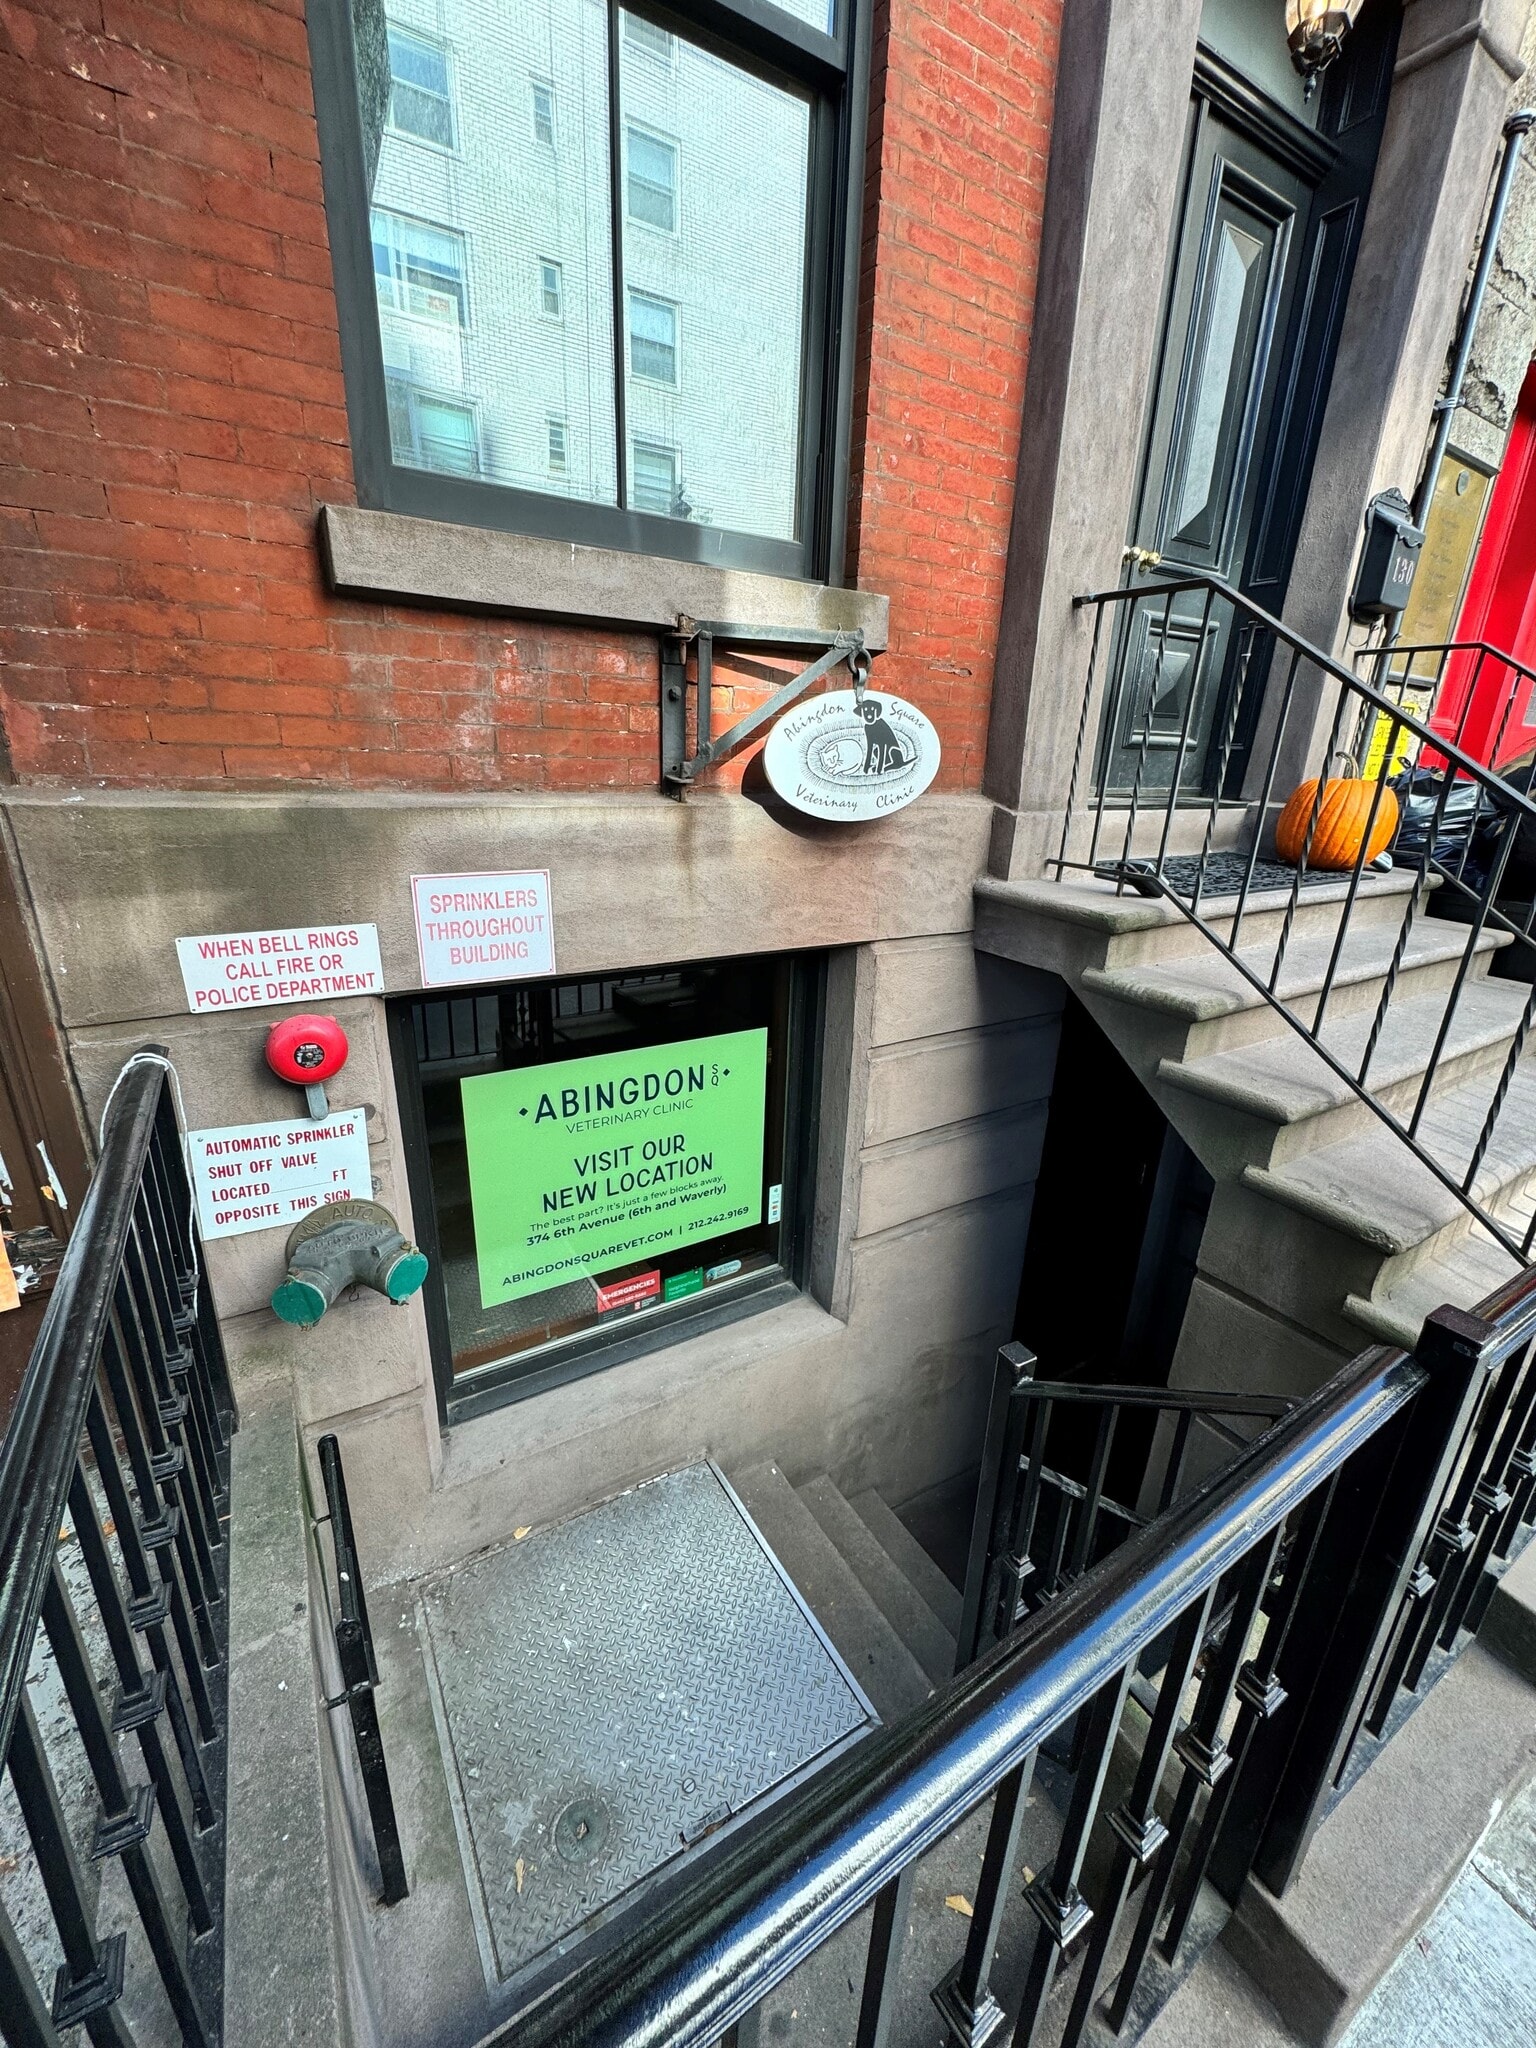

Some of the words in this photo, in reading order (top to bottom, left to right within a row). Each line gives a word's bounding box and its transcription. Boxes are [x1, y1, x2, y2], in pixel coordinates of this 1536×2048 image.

[1392, 556, 1415, 585] 130
[783, 702, 845, 742] Abingdon
[889, 701, 925, 729] Square
[796, 783, 859, 812] Veterinary
[876, 785, 915, 808] Clinic
[430, 889, 538, 914] SPRINKLERS
[198, 939, 254, 959] WHEN
[258, 935, 304, 954] BELL
[307, 930, 359, 949] RINGS
[426, 915, 544, 941] THROUGHOUT
[225, 961, 273, 980] CALL
[276, 957, 315, 975] FIRE
[319, 954, 344, 971] OR
[450, 941, 528, 965] BUILDING
[195, 985, 262, 1007] POLICE
[266, 972, 375, 999] DEPARTMENT
[534, 1064, 704, 1124] ABINGDON
[565, 1108, 650, 1134] VETERINARY
[653, 1099, 694, 1116] CLINIC
[206, 1135, 281, 1156] AUTOMATIC
[287, 1123, 355, 1145] SPRINKLER
[574, 1146, 634, 1177] VISIT
[642, 1134, 685, 1161] OUR
[208, 1163, 242, 1179] SHUT
[250, 1159, 273, 1173] OFF
[281, 1152, 318, 1169] VALVE
[543, 1181, 597, 1213] NEW
[606, 1152, 713, 1197] LOCATION
[212, 1182, 270, 1203] LOCATED
[332, 1169, 348, 1182] FT
[215, 1203, 281, 1225] OPPOSITE
[289, 1196, 318, 1211] THIS
[323, 1189, 351, 1204] SIGN
[526, 1233, 550, 1246] 374
[553, 1225, 575, 1239] 6th
[578, 1212, 625, 1232] Avenue
[628, 1205, 652, 1220] (6th
[655, 1197, 677, 1211] and
[679, 1183, 727, 1204] Waverly)
[530, 1221, 550, 1232] The
[553, 1214, 575, 1226] best
[578, 1206, 604, 1221] part?
[606, 1202, 621, 1212] It's
[622, 1197, 640, 1209] just
[651, 1190, 668, 1200] few
[670, 1182, 698, 1195] blocks
[502, 1229, 673, 1286] ABINGDONSQUAREVET.COM
[688, 1206, 749, 1231] 212.242.9169
